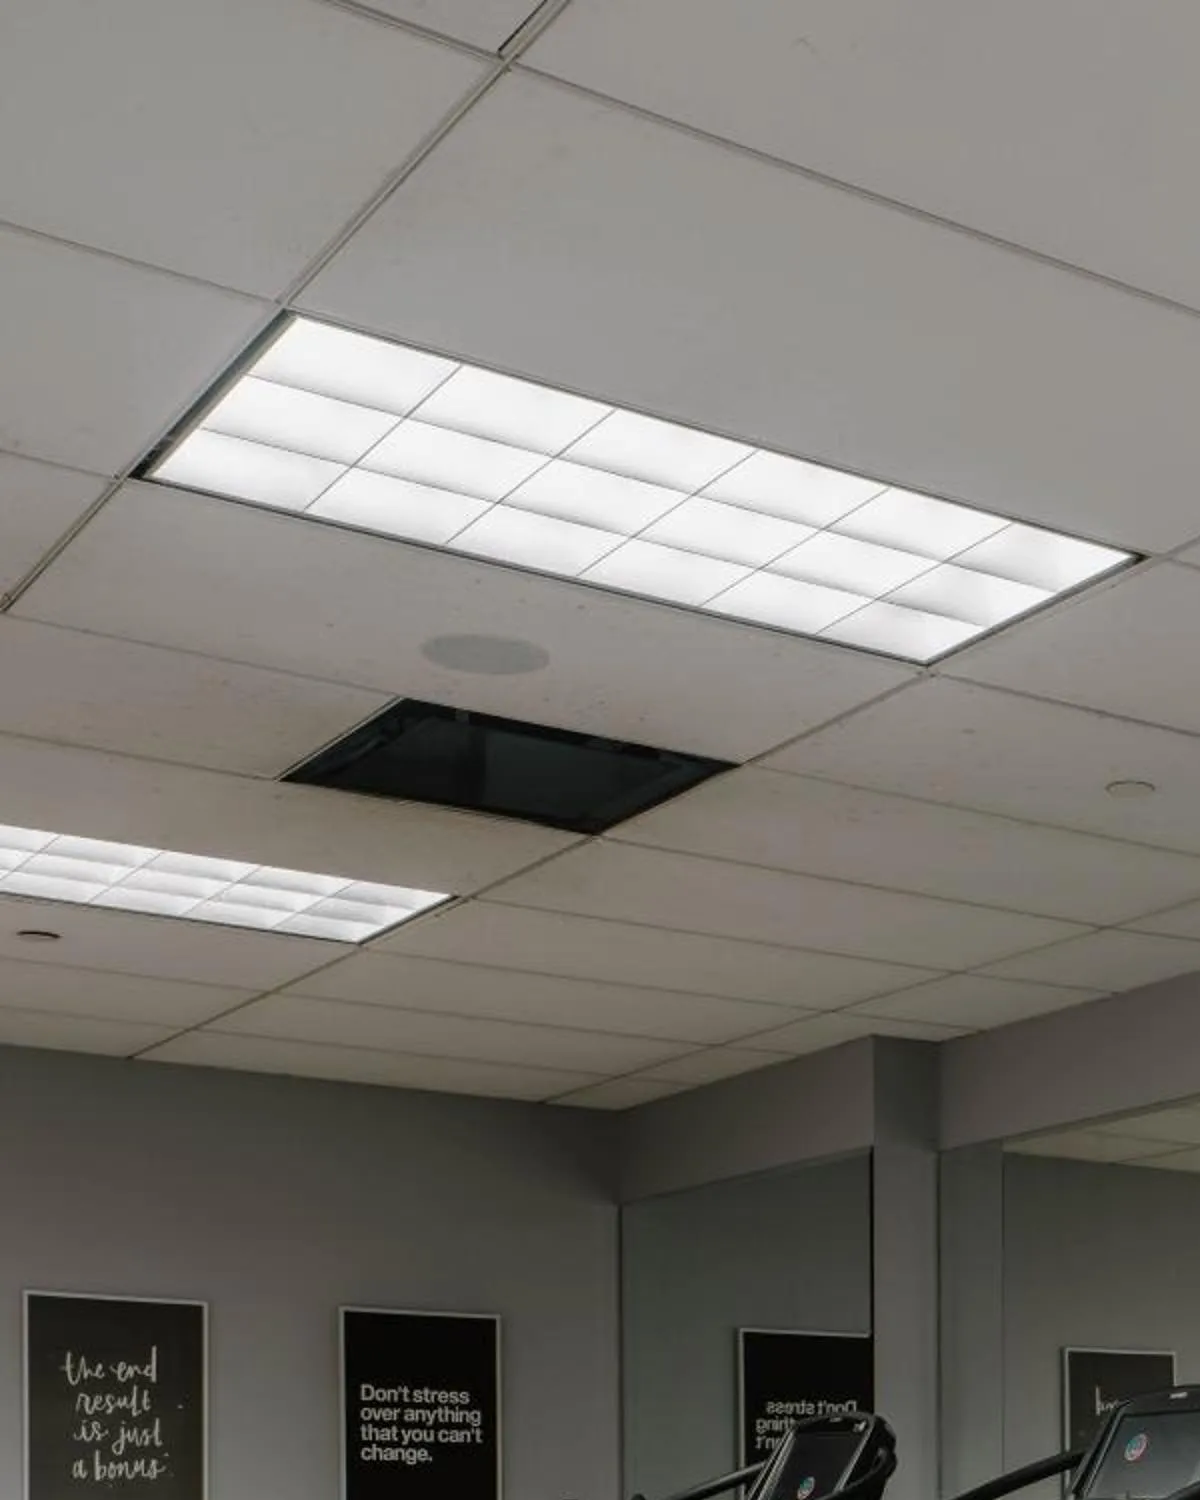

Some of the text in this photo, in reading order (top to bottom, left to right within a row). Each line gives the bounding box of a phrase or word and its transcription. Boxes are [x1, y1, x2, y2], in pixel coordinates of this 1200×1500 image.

[59, 1345, 157, 1385] the end
[75, 1384, 151, 1417] result
[360, 1383, 471, 1405] Don't stress
[360, 1405, 482, 1427] over anything
[73, 1417, 163, 1456] is just
[360, 1423, 483, 1446] that you can't
[72, 1449, 167, 1482] a bonus
[360, 1443, 433, 1465] change.
